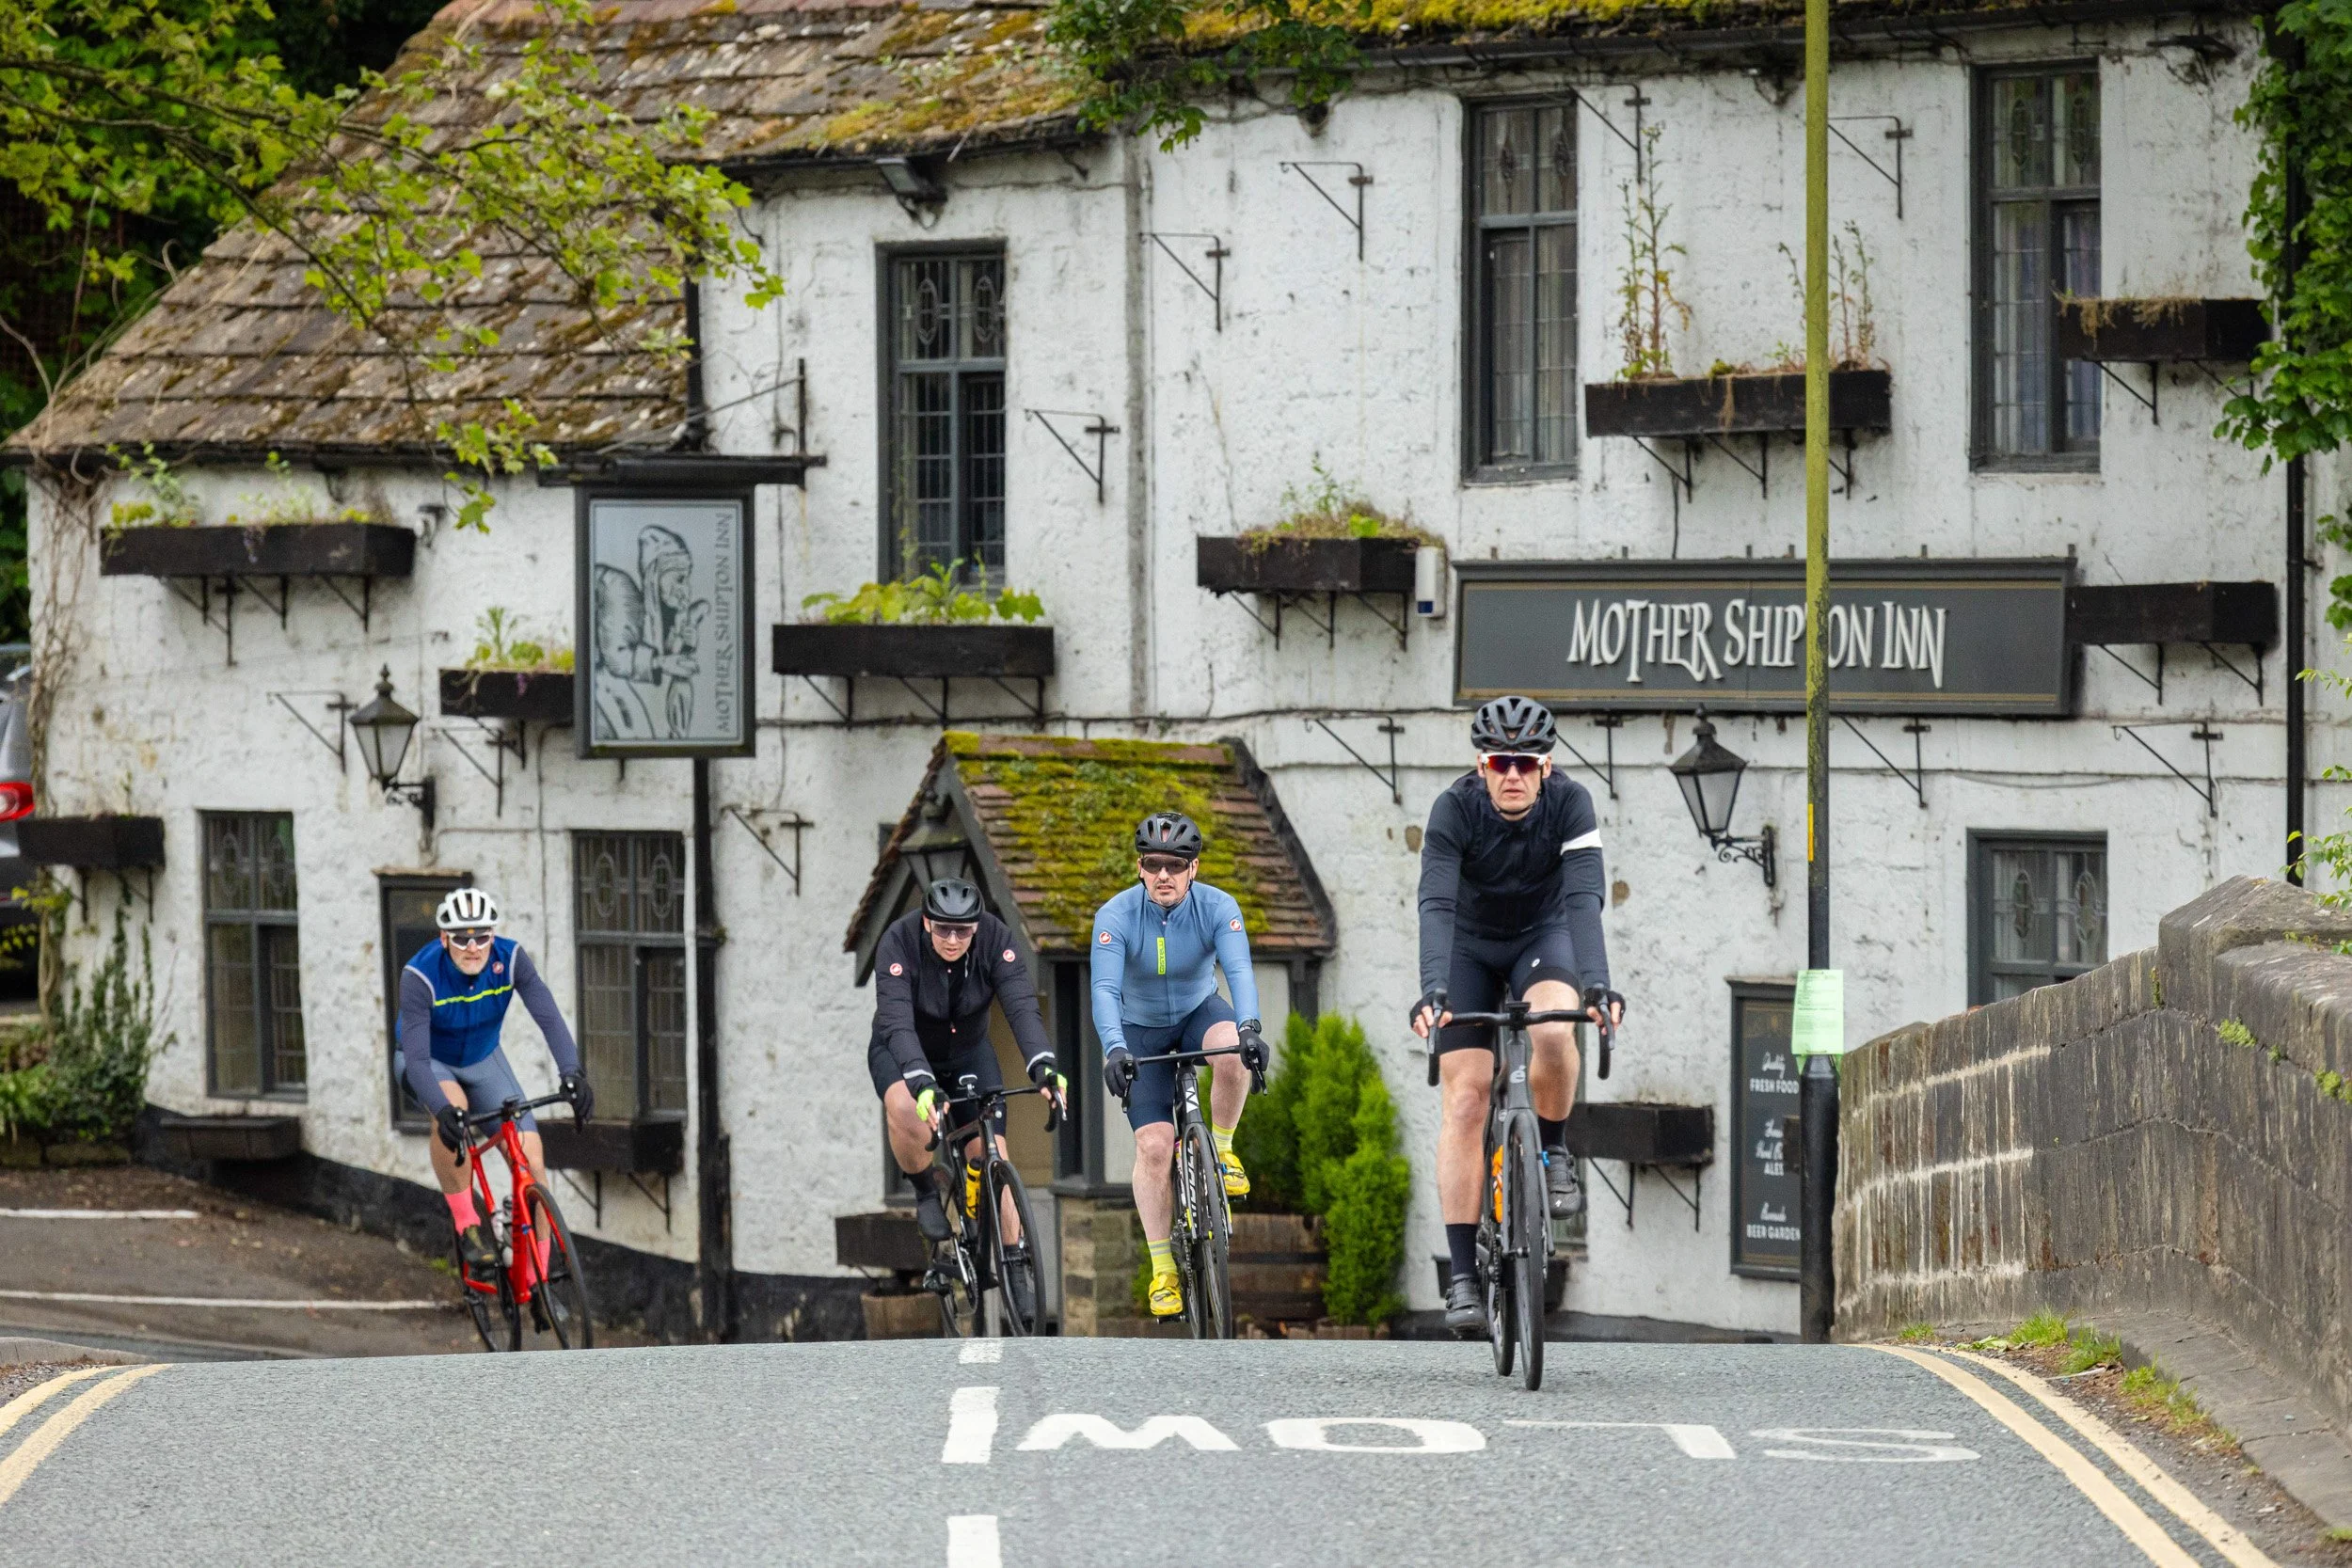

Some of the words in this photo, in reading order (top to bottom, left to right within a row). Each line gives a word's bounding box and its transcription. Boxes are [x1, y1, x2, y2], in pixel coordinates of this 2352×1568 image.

[715, 512, 734, 550] INN
[714, 554, 734, 642] SHIPTON
[1565, 599, 1724, 683] MOTHER
[1724, 597, 1874, 669] SHIPON
[1882, 601, 1947, 689] INN
[714, 643, 734, 733] MOTHER
[1749, 1078, 1775, 1093] FRESH
[1775, 1079, 1800, 1094] FOOD
[1767, 1224, 1801, 1241] GARDEN
[1015, 1413, 1981, 1462] SLOW
